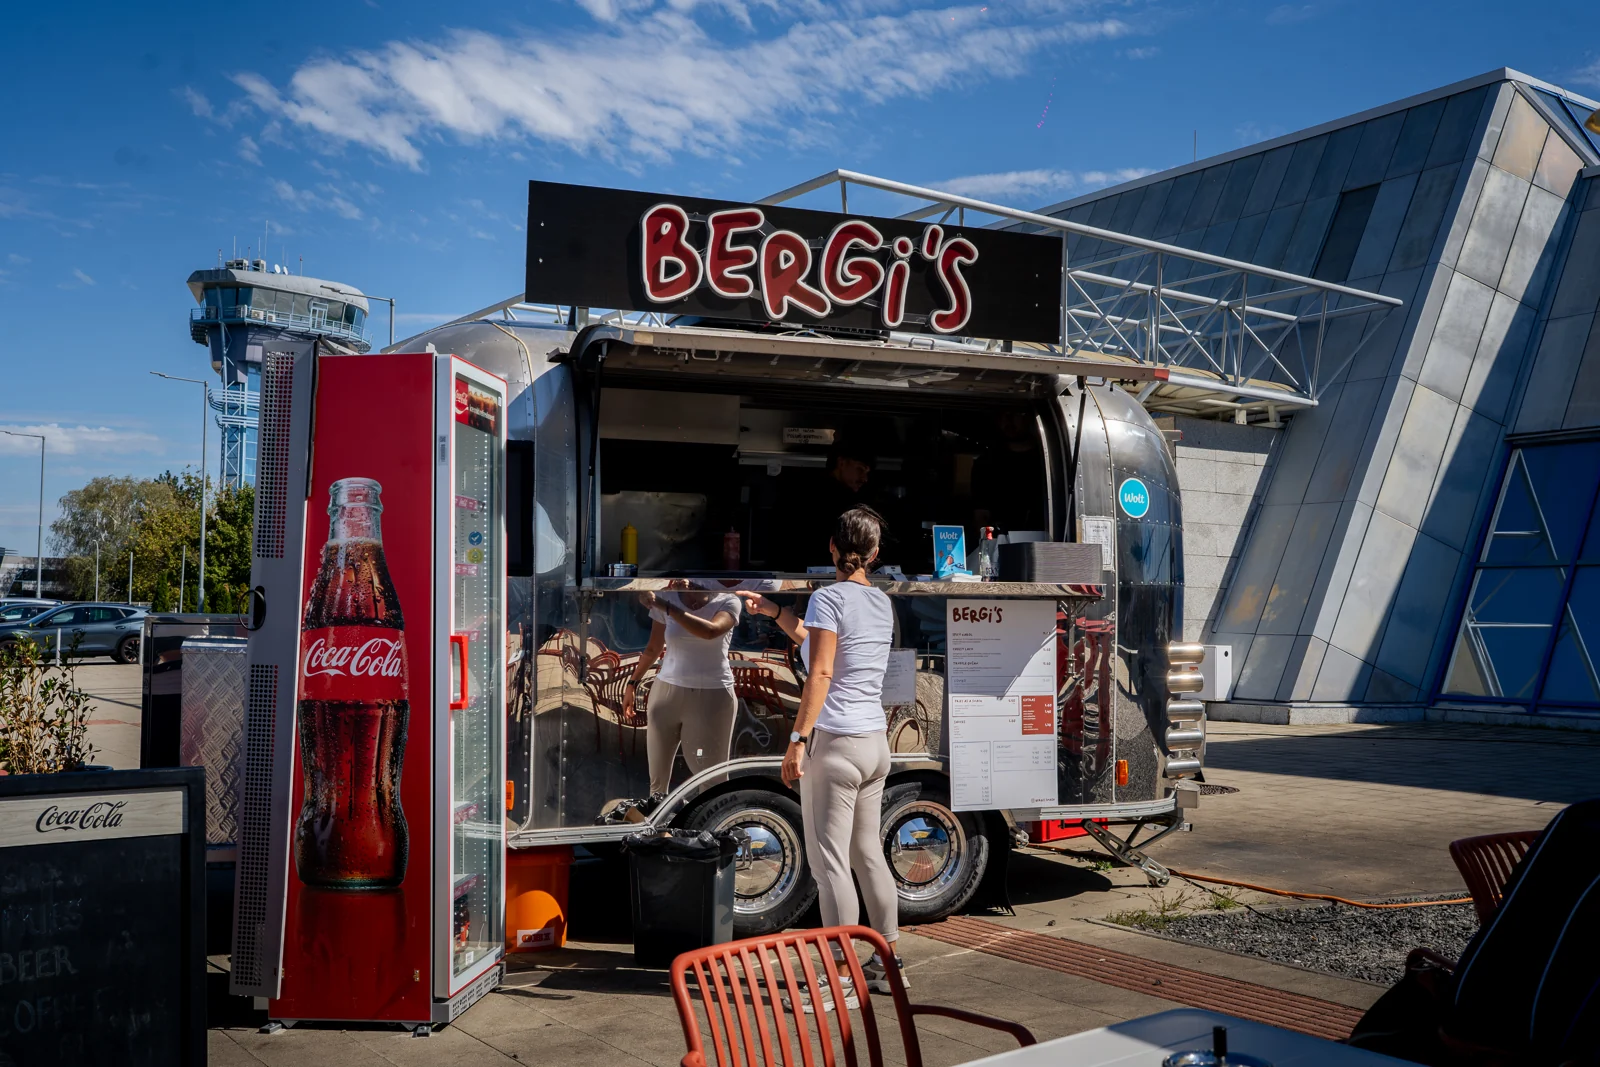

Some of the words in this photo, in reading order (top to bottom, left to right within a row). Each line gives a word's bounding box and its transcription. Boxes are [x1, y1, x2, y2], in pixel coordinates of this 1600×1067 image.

[1124, 491, 1145, 504] Wolt
[939, 531, 959, 540] Wolt
[303, 637, 403, 677] Coca-Cola
[35, 800, 128, 833] Coca-Cola
